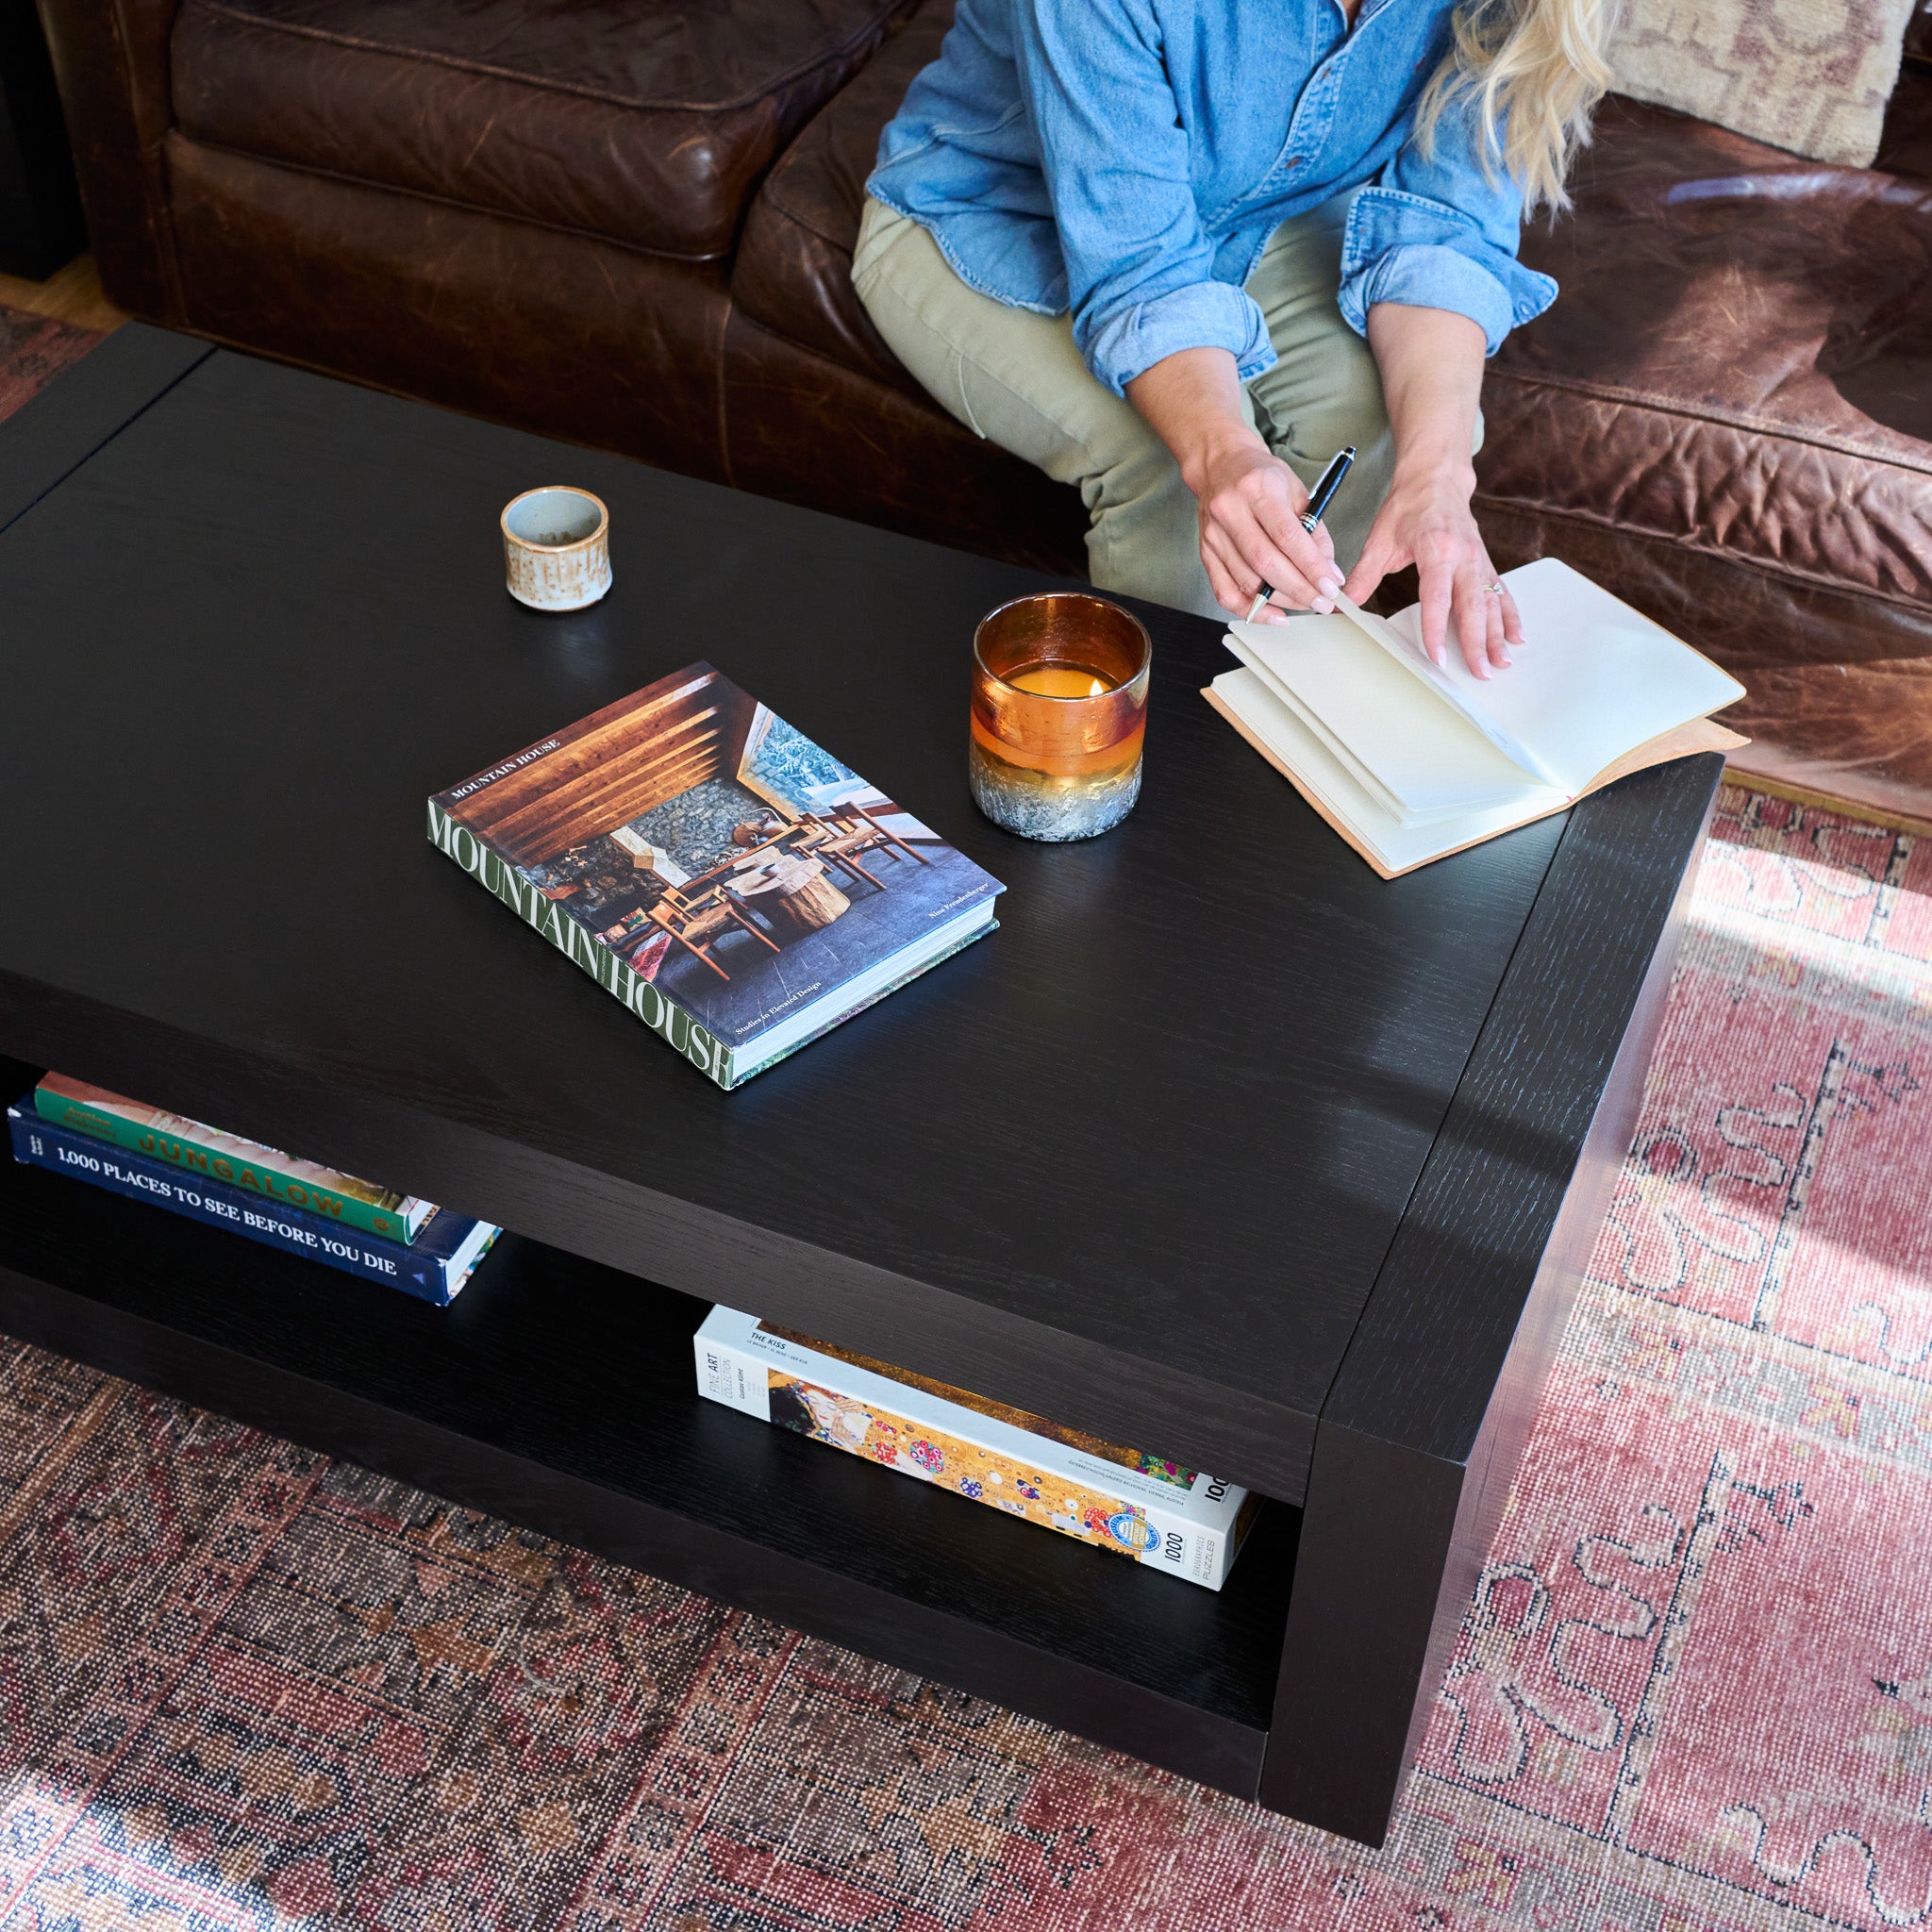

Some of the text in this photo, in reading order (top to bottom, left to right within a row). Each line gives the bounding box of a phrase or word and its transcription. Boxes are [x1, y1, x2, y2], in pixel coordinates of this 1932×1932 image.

[451, 739, 560, 799] MOUNTAIN HOUSE
[928, 908, 945, 919] Nina
[427, 799, 734, 1090] MOUNTAIN HOUSE
[736, 981, 822, 1034] Studies in Elevated Design
[139, 1134, 342, 1216] JUNGALOW
[58, 1147, 397, 1275] 1,000 PLACES TO SEE BEFORE YOU DIE
[751, 1332, 787, 1350] THE KISS
[708, 1352, 721, 1394] FINE ART
[722, 1359, 734, 1399] COLLECTION
[1164, 1532, 1183, 1563] 1000
[1203, 1540, 1215, 1580] PUZZLES
